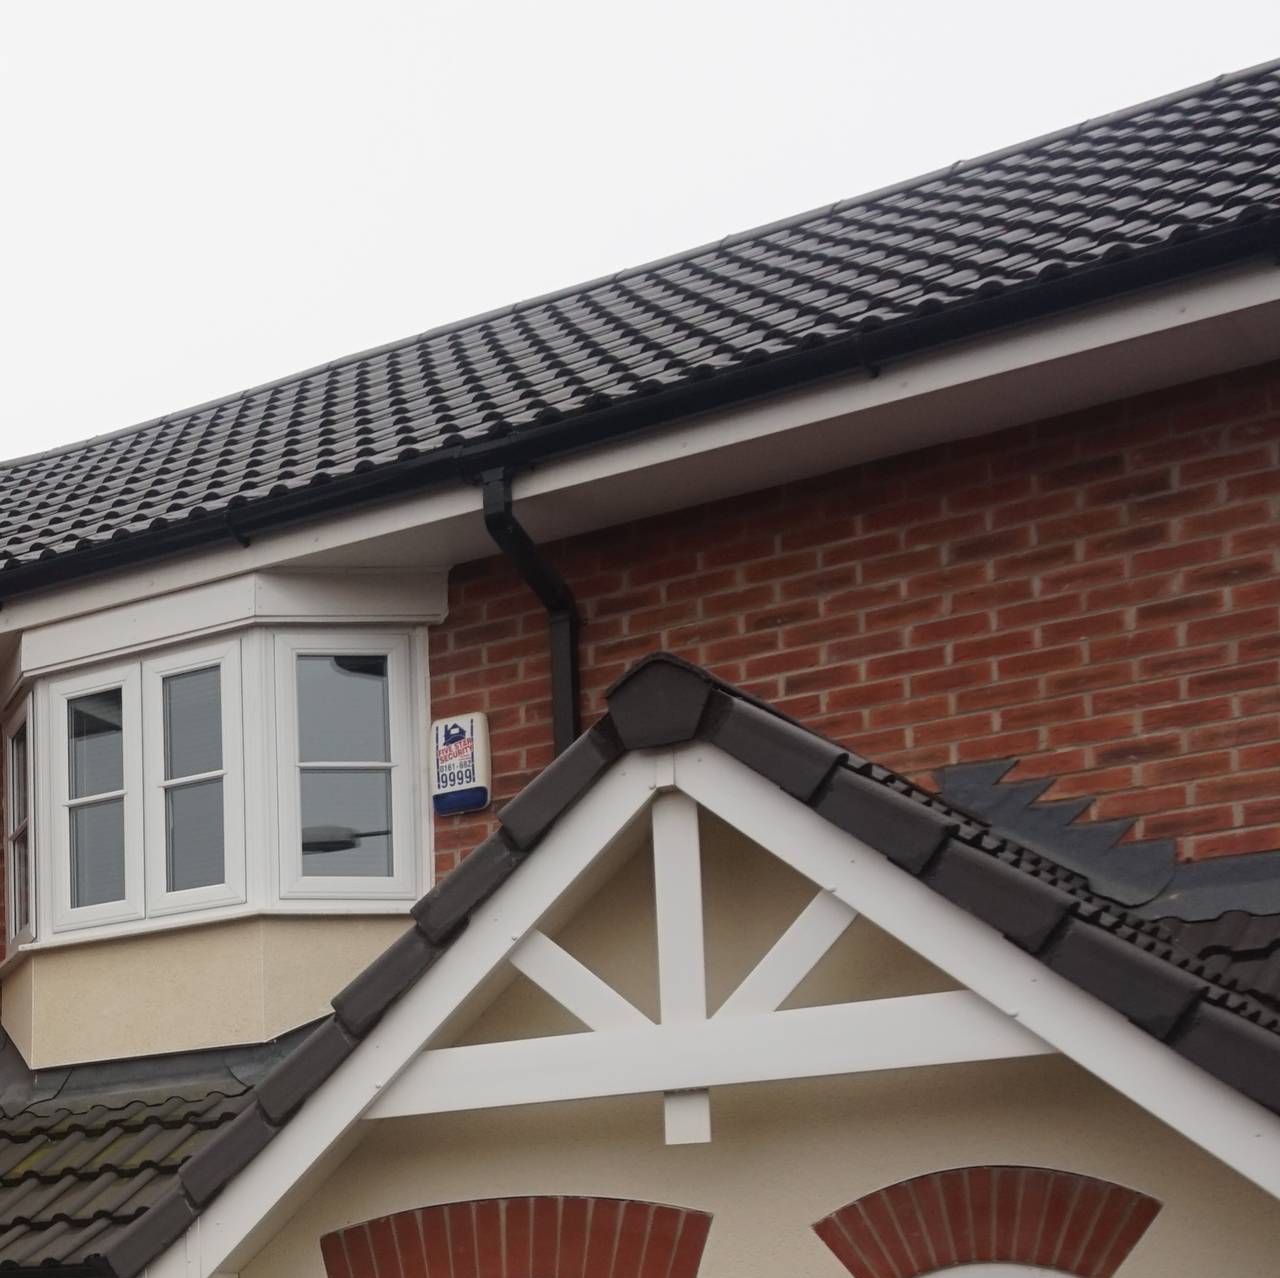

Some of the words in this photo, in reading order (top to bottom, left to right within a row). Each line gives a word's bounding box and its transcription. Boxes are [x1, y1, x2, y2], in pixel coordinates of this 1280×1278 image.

[455, 737, 472, 750] STAR
[439, 746, 471, 764] SECURITY
[441, 768, 472, 788] 9999
